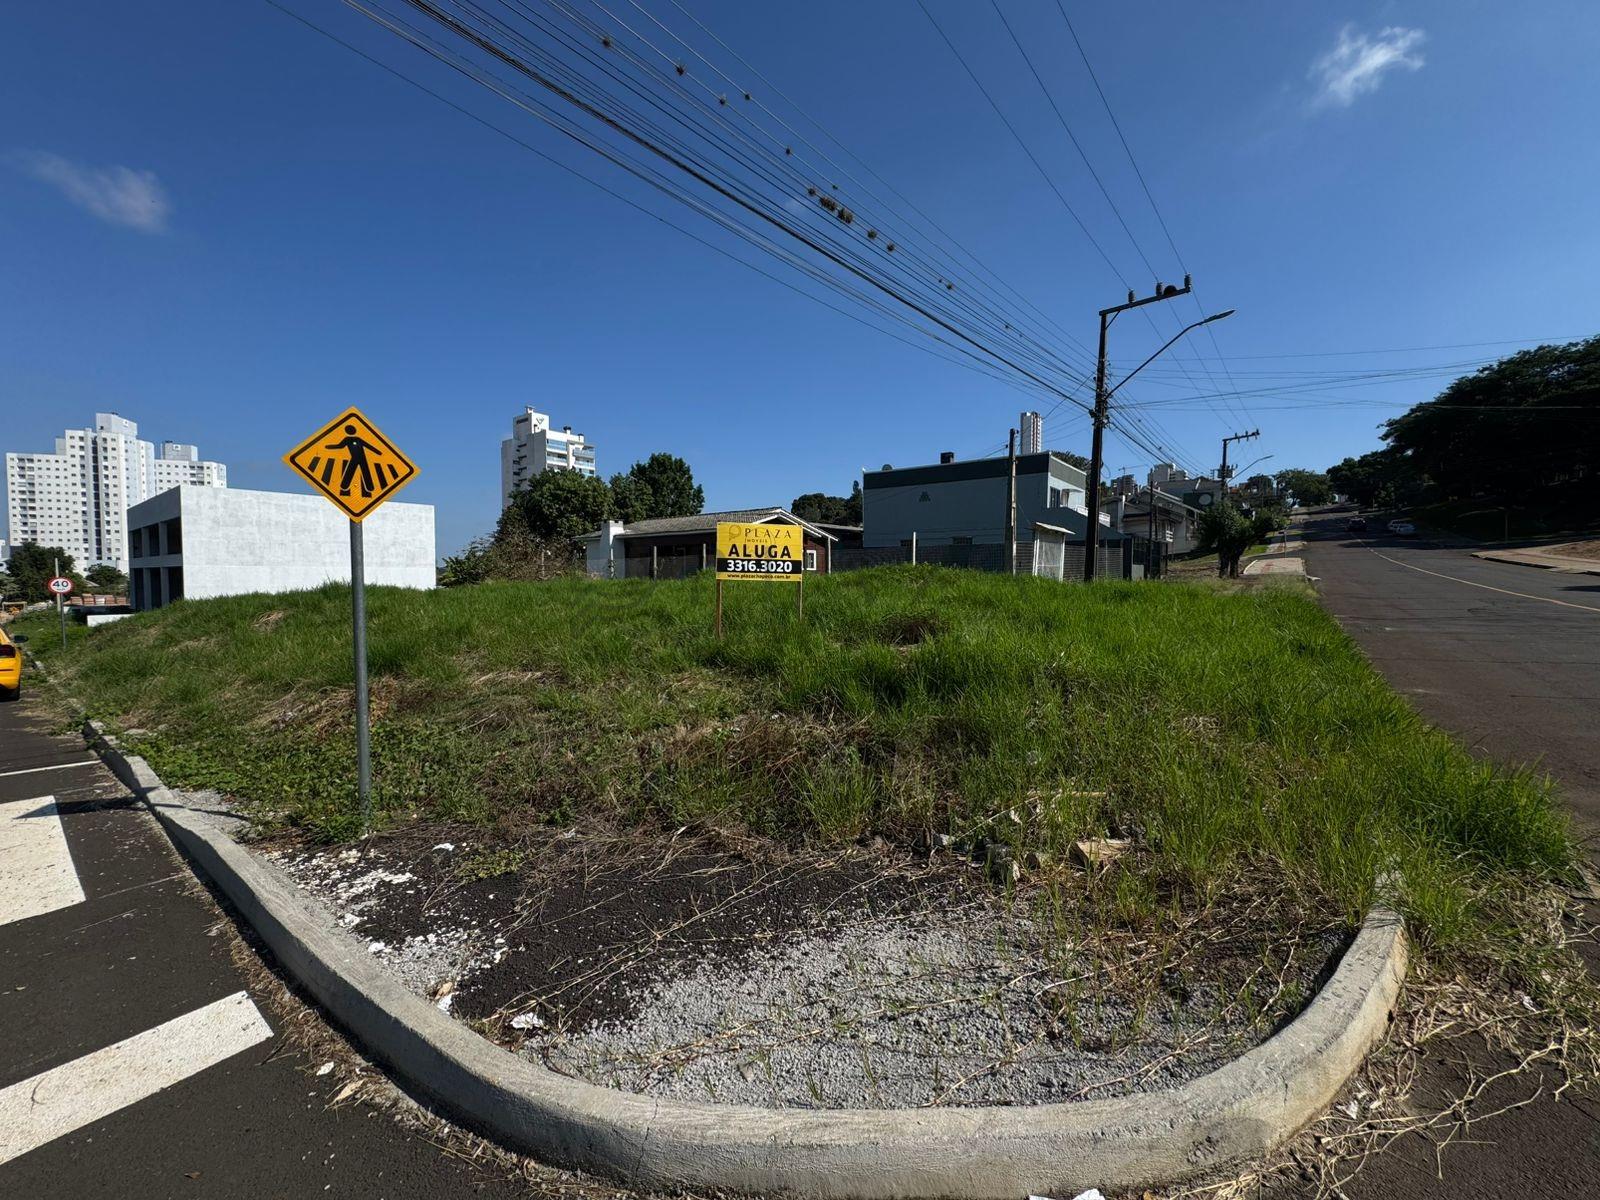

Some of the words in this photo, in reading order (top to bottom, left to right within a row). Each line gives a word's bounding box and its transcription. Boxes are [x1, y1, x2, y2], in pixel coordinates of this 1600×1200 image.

[744, 528, 792, 539] PLAZA
[728, 544, 792, 558] ALUGA
[726, 560, 792, 572] 3316.3020
